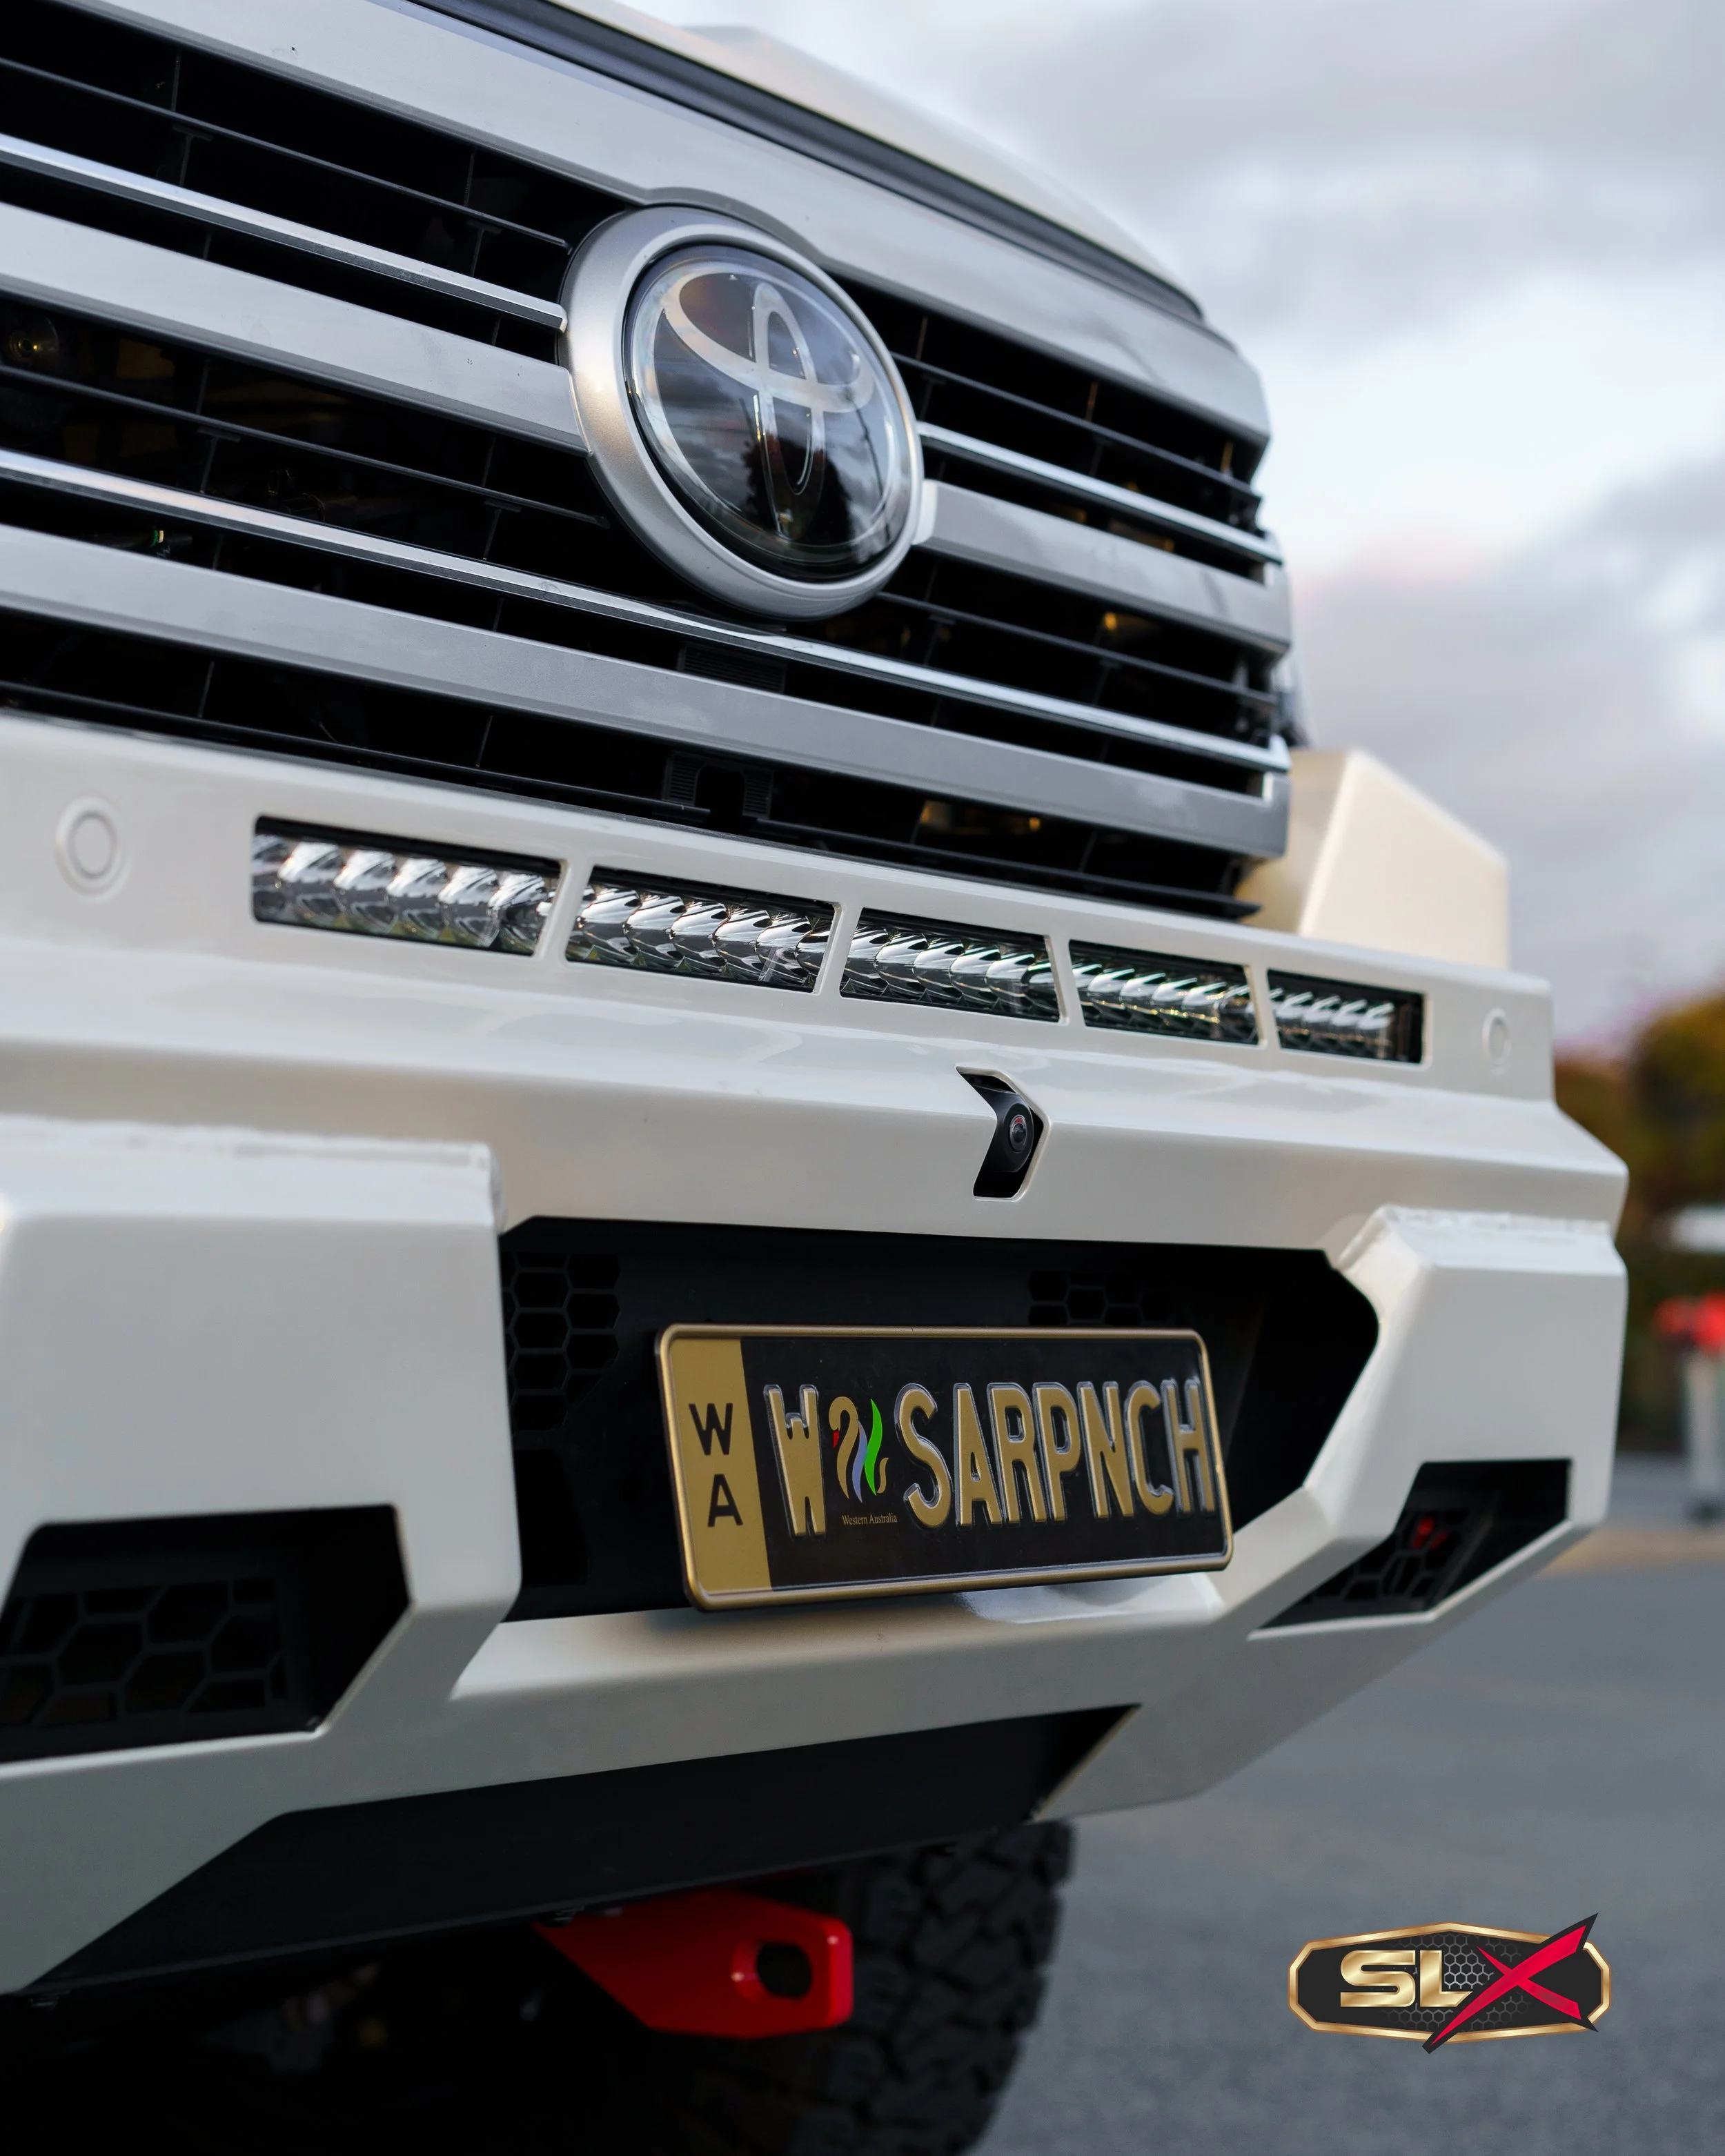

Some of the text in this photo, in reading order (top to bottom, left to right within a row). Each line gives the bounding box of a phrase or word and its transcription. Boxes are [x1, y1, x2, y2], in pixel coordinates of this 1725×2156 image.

[896, 1380, 1216, 1529] SARPNCH
[842, 1512, 898, 1525] Western Australia
